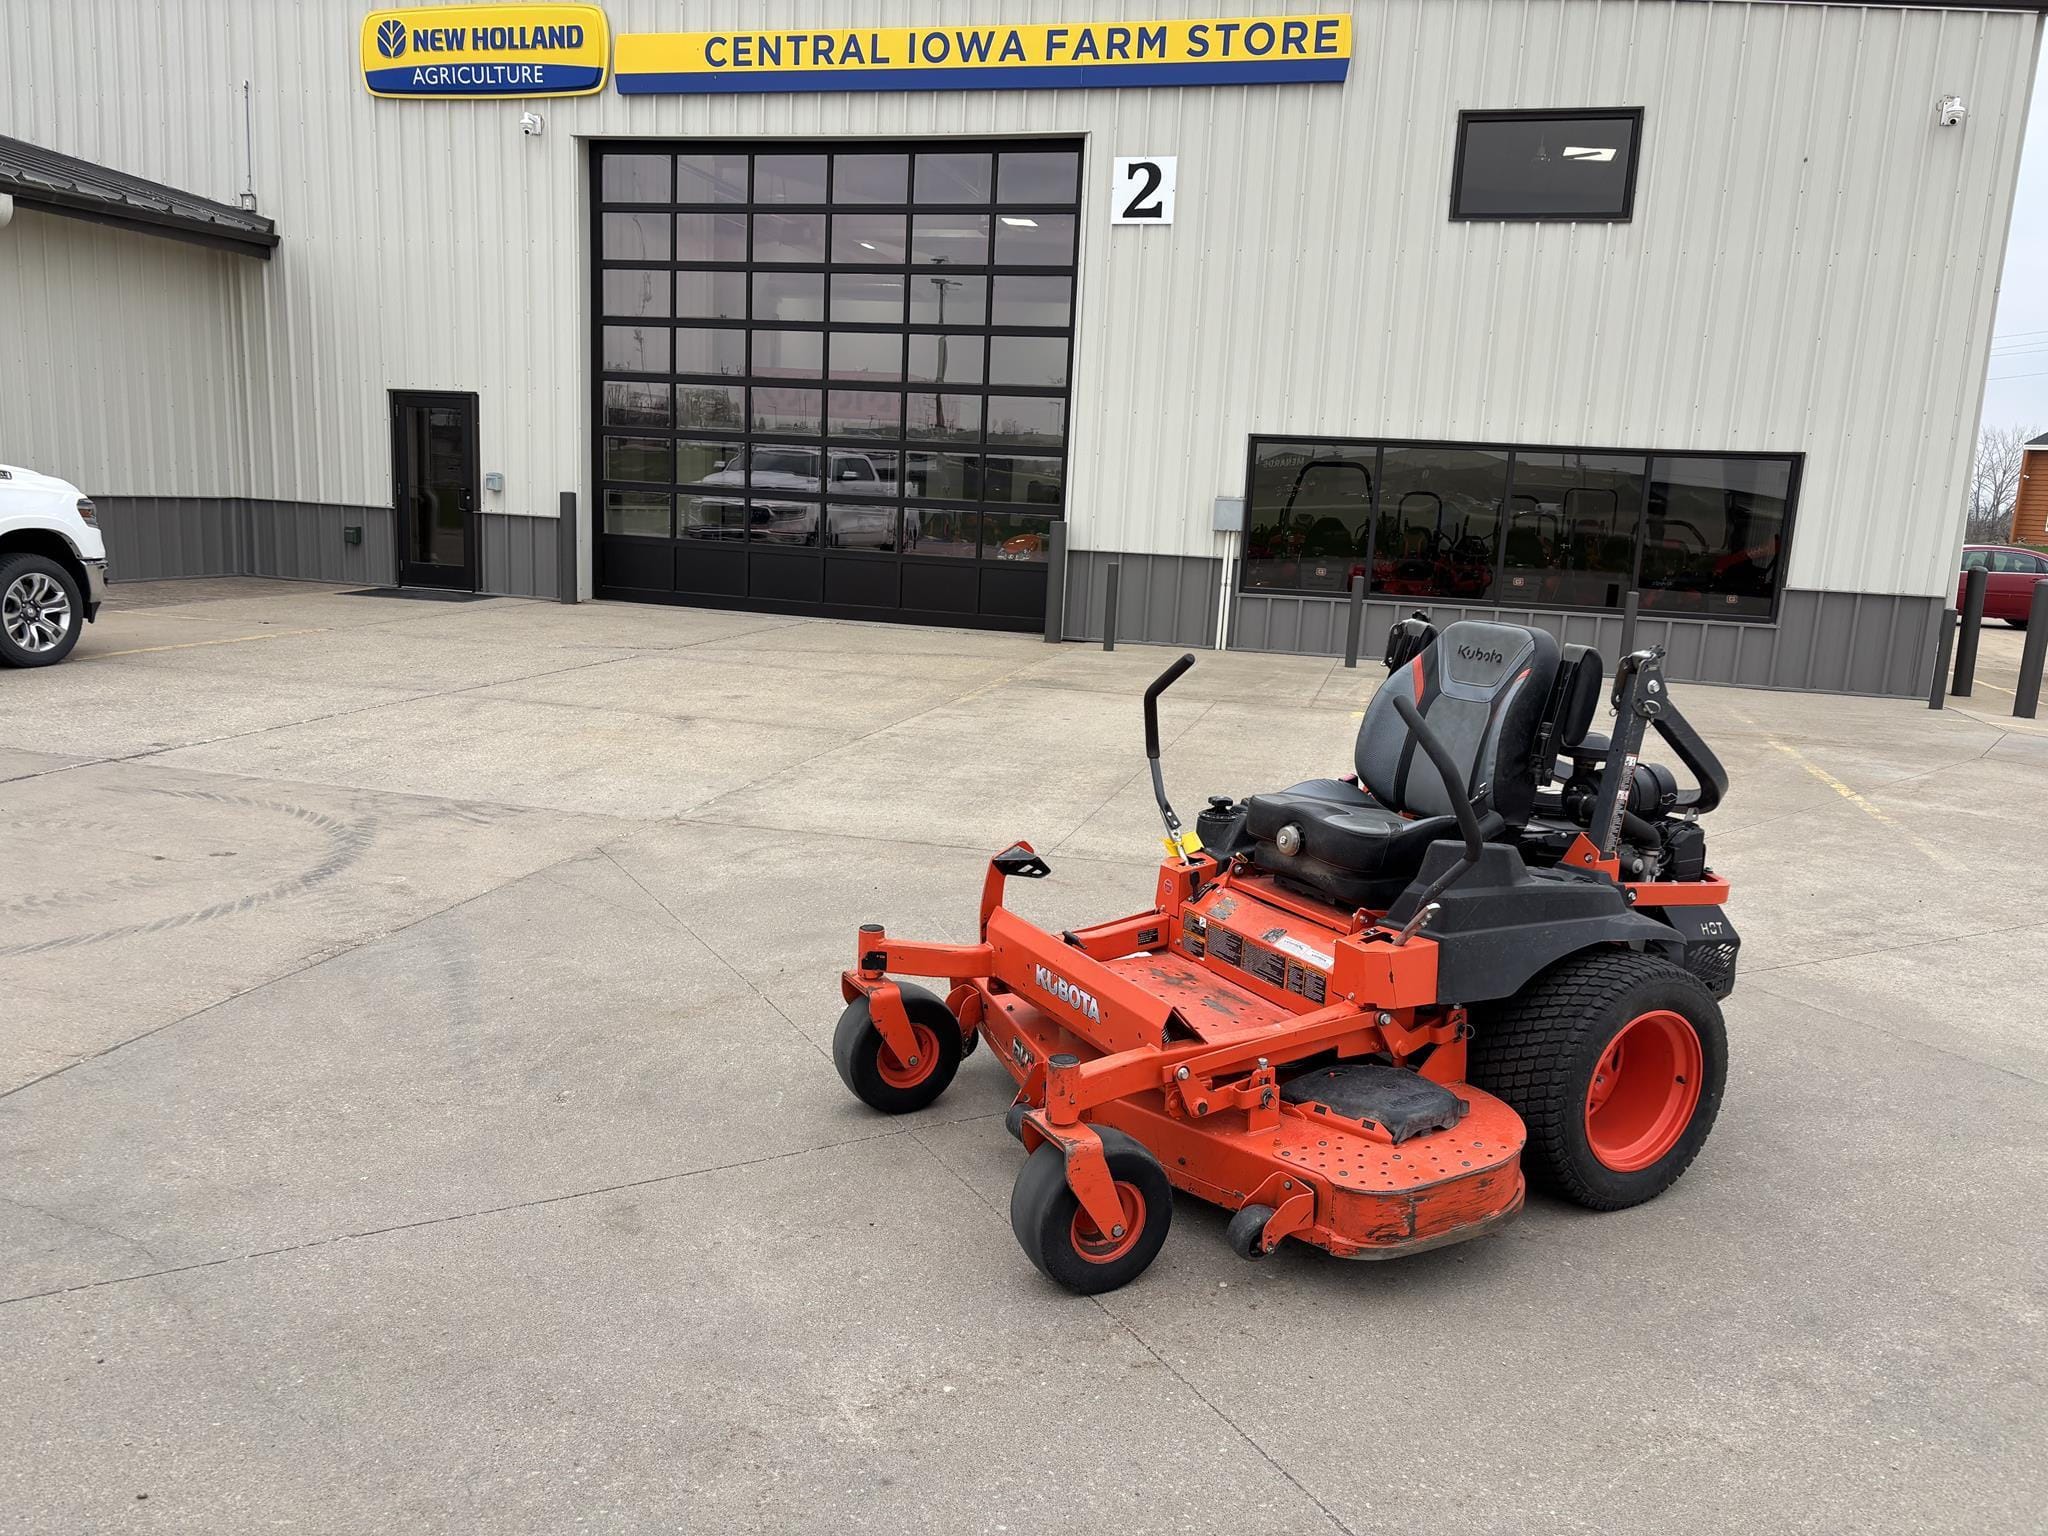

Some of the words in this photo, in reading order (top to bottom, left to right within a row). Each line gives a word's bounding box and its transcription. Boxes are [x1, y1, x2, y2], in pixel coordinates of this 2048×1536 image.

[413, 28, 466, 51] NEW
[472, 25, 584, 50] HOLLAND
[705, 33, 890, 67] CENTRAL
[908, 31, 1026, 64] IOWA
[1046, 26, 1167, 60] FARM
[1186, 20, 1339, 57] STORE
[413, 65, 544, 84] AGRICULTURE
[1122, 161, 1163, 218] 2
[1458, 645, 1502, 663] Kubota
[1700, 921, 1722, 935] HOT
[1035, 963, 1101, 1024] KUBOTA
